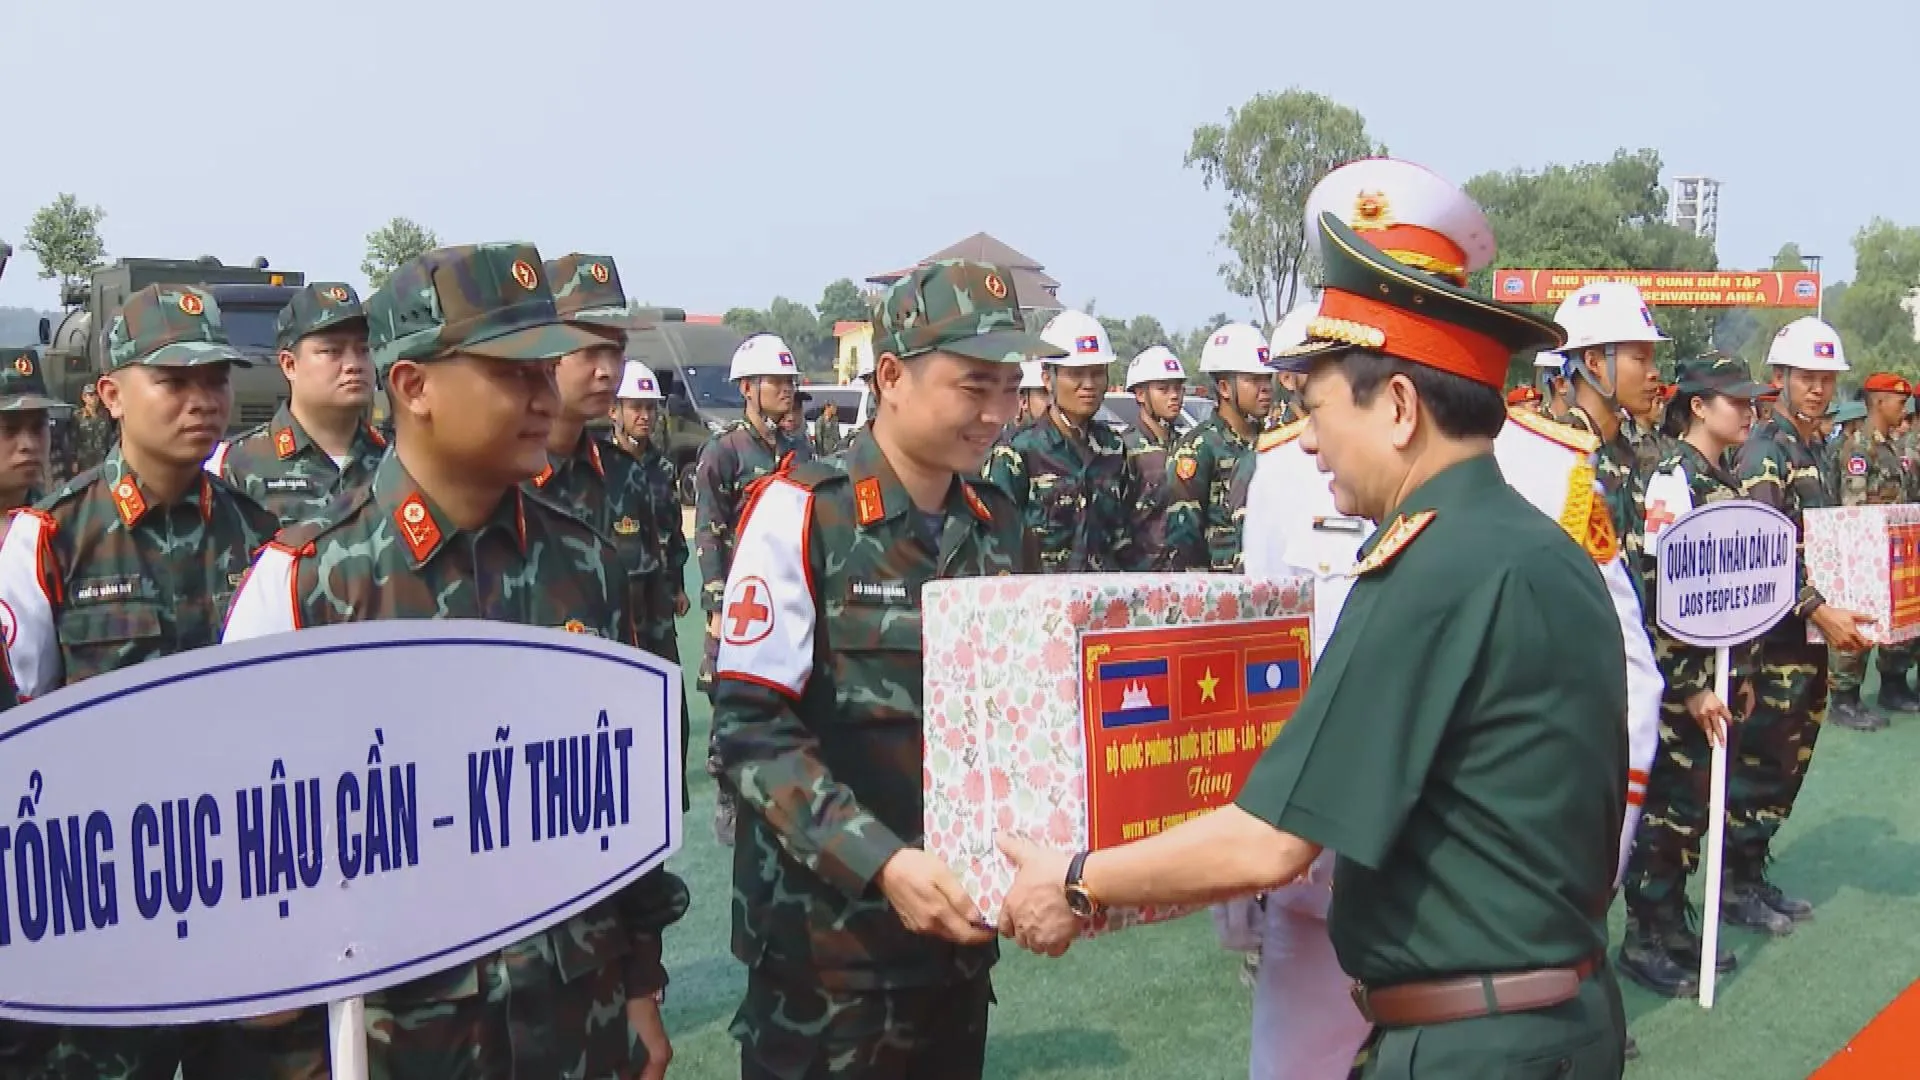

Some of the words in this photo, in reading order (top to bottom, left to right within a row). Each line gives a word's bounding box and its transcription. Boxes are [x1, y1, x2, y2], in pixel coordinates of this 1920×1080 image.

[1552, 275, 1580, 286] KHU
[1656, 276, 1694, 289] QUAN
[1734, 275, 1762, 291] TẬP
[1641, 291, 1722, 303] SERVATION
[1726, 291, 1767, 303] AREA
[1667, 533, 1697, 585] QUÂN
[1699, 533, 1717, 584] ĐỘI
[1719, 530, 1747, 573] NHÂN
[1750, 528, 1769, 570] DÂN
[1771, 525, 1789, 568] LÀO
[1679, 593, 1704, 619] LAOS
[1706, 586, 1750, 614] PEOPLE'S
[1752, 582, 1777, 607] ARMY
[1105, 740, 1120, 777] BỘ
[1120, 734, 1144, 773] QUỐC
[1145, 732, 1173, 767] PHÒNG
[1174, 735, 1179, 763] 3
[1179, 726, 1200, 759] NƯỚC
[1200, 725, 1216, 762] VIỆT
[1217, 727, 1236, 754] NAM
[1241, 720, 1256, 751] LÀO
[1187, 766, 1233, 802] Tặng
[0, 769, 119, 947] TỔNG
[131, 793, 223, 939] CỤC
[235, 757, 322, 919] HẬU
[335, 727, 419, 880] CẦN
[468, 725, 514, 854] KỸ
[524, 709, 634, 852] THUẬT
[1122, 822, 1145, 841] WITH
[1145, 817, 1161, 837] THE
